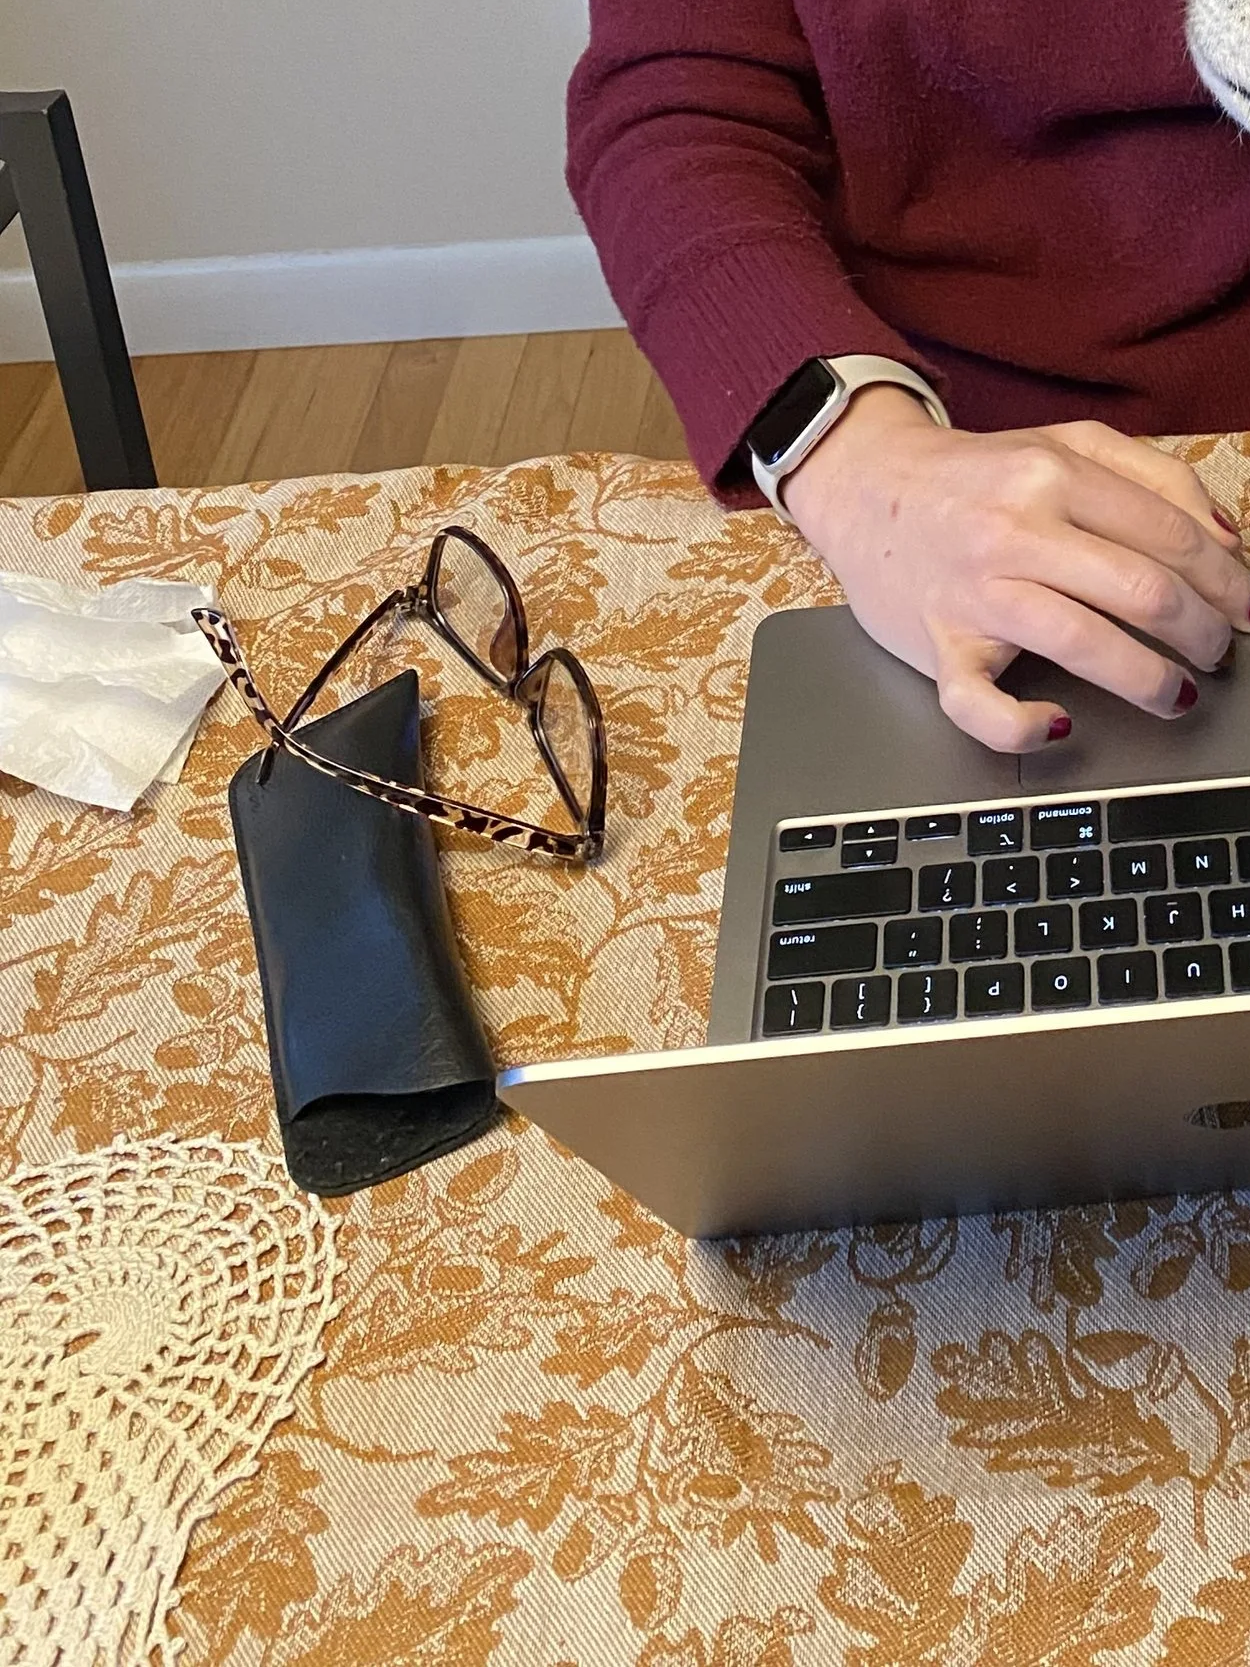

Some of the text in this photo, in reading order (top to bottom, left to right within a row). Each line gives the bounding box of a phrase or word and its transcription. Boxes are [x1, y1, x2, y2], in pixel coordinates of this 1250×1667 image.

[979, 813, 1015, 825] option
[1038, 806, 1093, 821] command
[1131, 861, 1147, 875] M
[1195, 855, 1209, 869] N
[784, 882, 812, 894] shift
[942, 888, 952, 903] ?
[1169, 909, 1179, 925] J
[1231, 903, 1245, 919] H
[1037, 922, 1048, 936] L
[1102, 916, 1115, 931] K
[779, 934, 816, 946] return
[1125, 969, 1130, 984] I
[1187, 962, 1201, 978] U
[987, 981, 1000, 996] P
[1054, 975, 1068, 991] O
